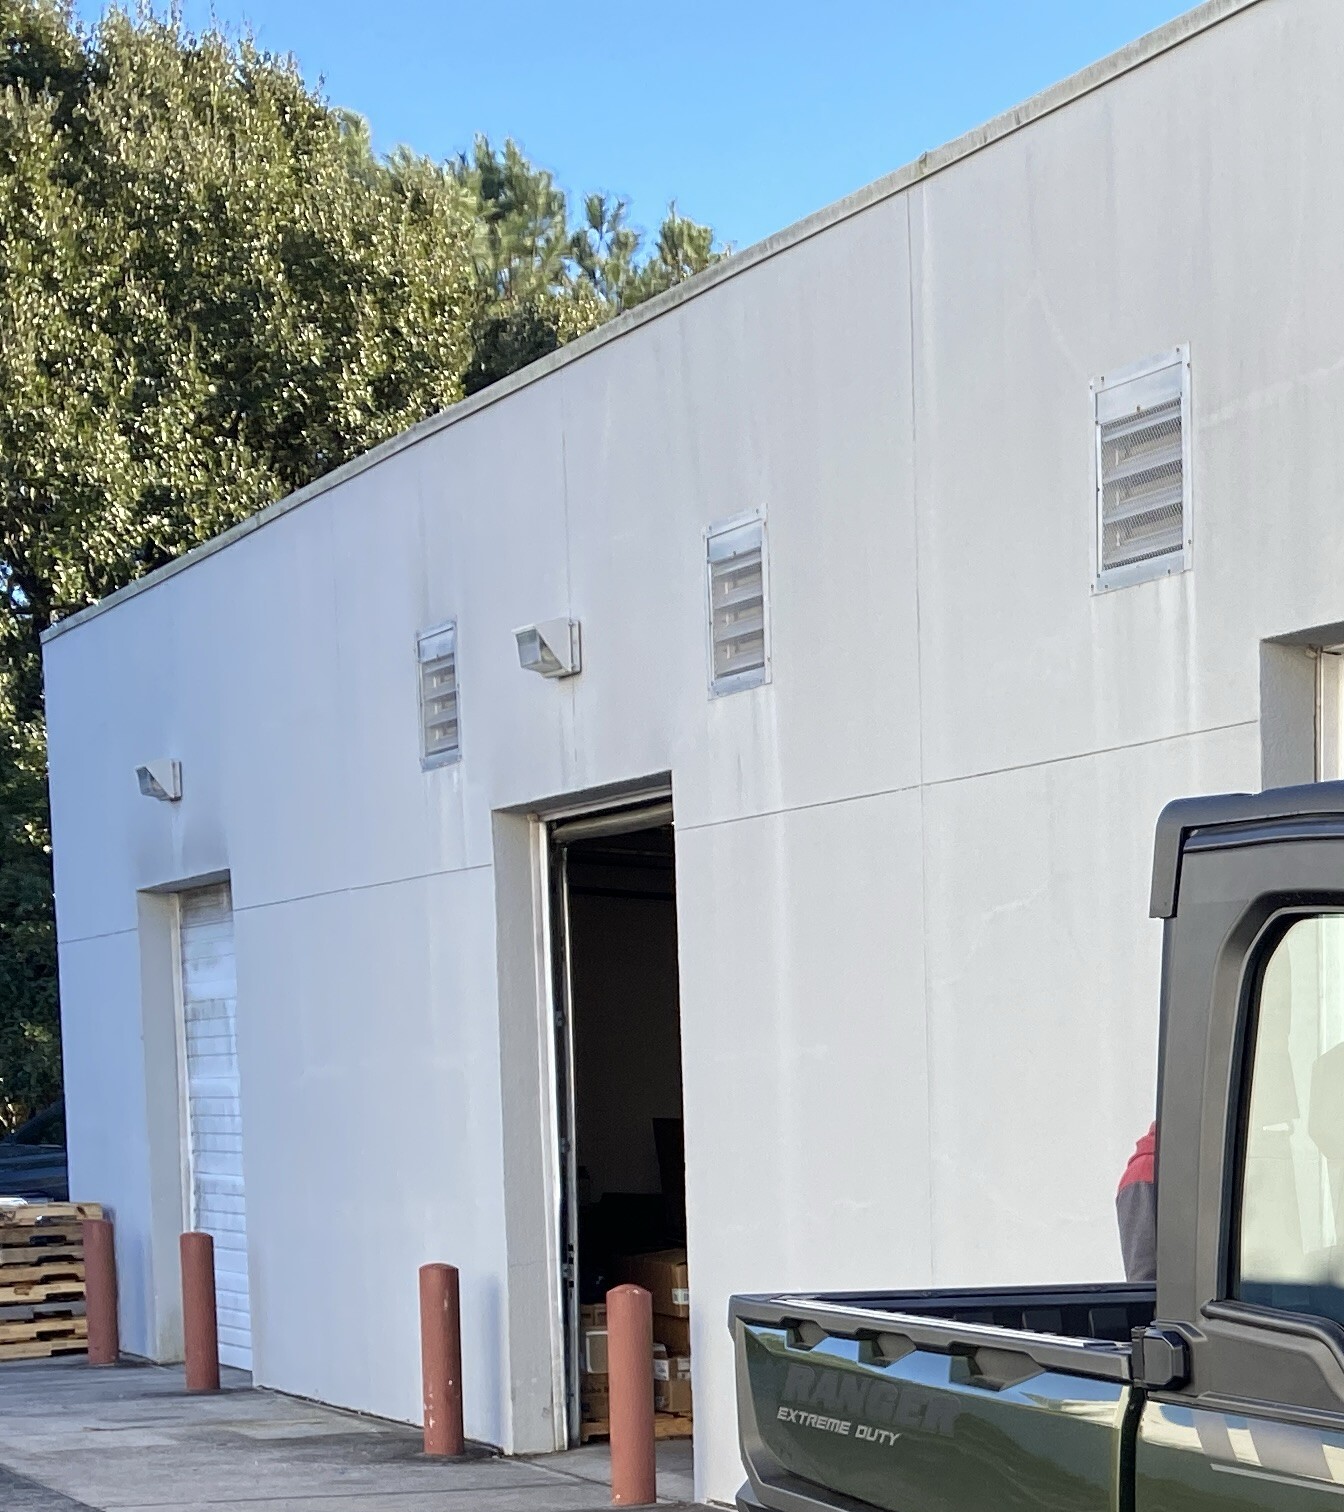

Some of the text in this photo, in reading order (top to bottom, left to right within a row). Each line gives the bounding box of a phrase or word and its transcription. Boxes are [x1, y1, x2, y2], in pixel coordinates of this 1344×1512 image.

[777, 1407, 904, 1447] EXTREME DUTY
[782, 1365, 961, 1438] RANGER
